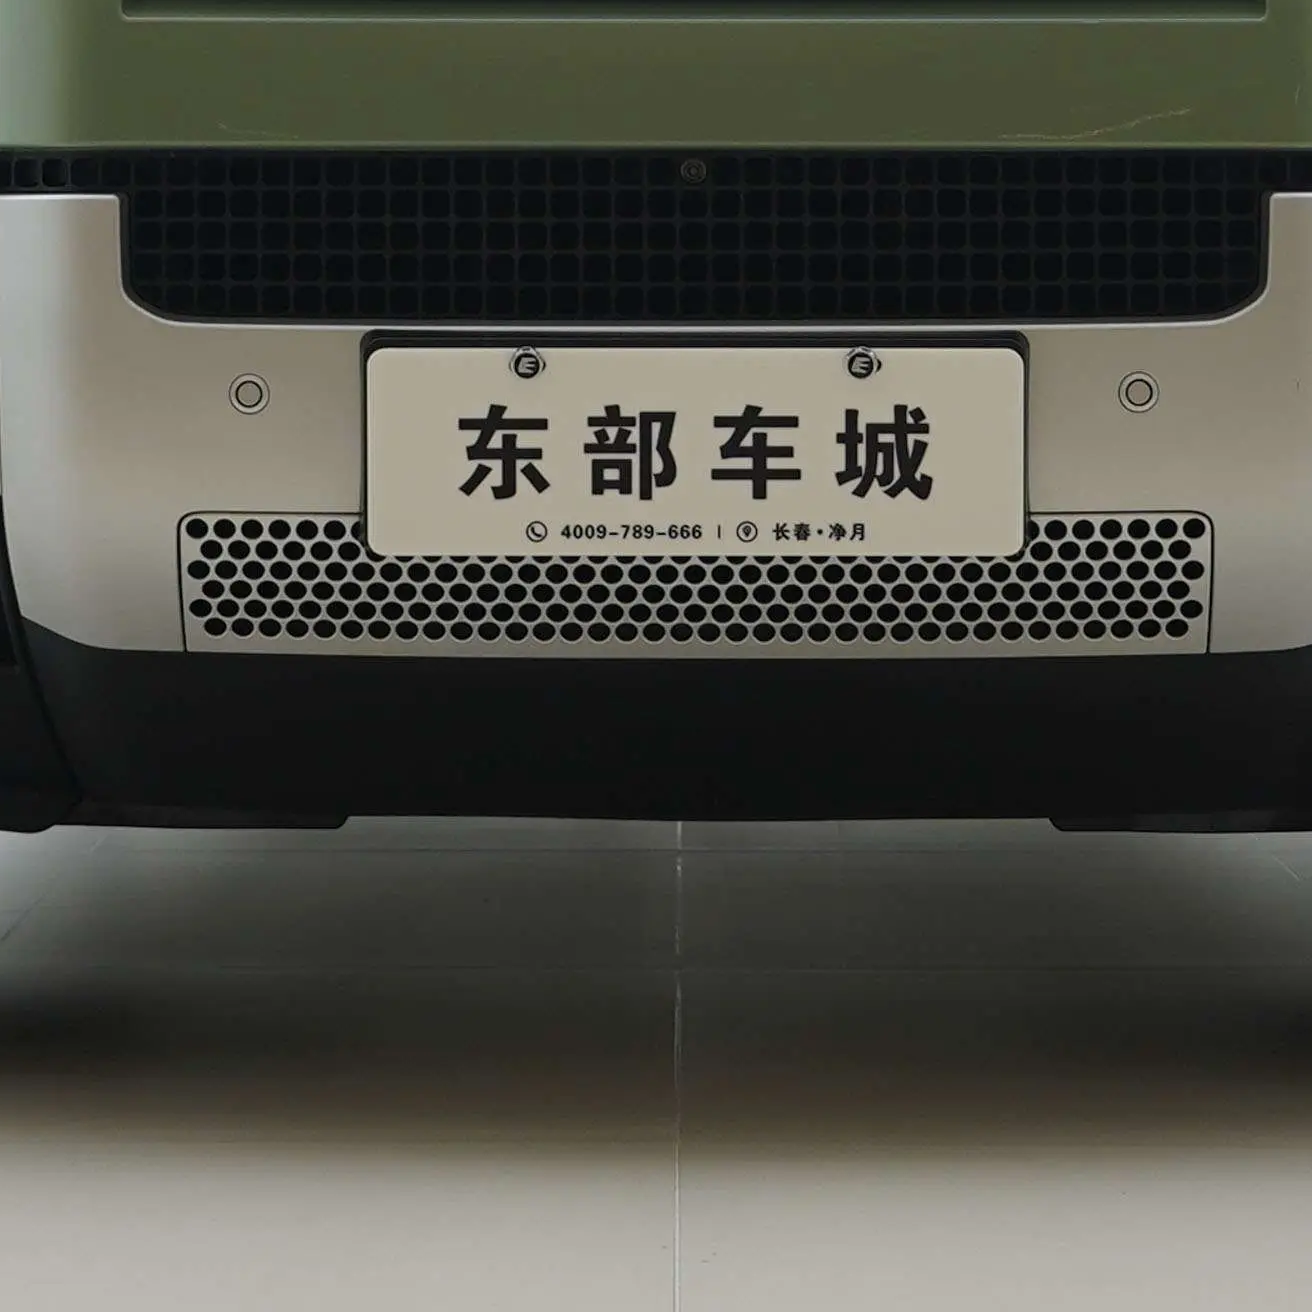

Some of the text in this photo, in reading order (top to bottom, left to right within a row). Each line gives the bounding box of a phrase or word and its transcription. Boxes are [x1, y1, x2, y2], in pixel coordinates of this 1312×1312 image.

[457, 403, 934, 501] 东部车城
[559, 524, 703, 540] 4009-789-666
